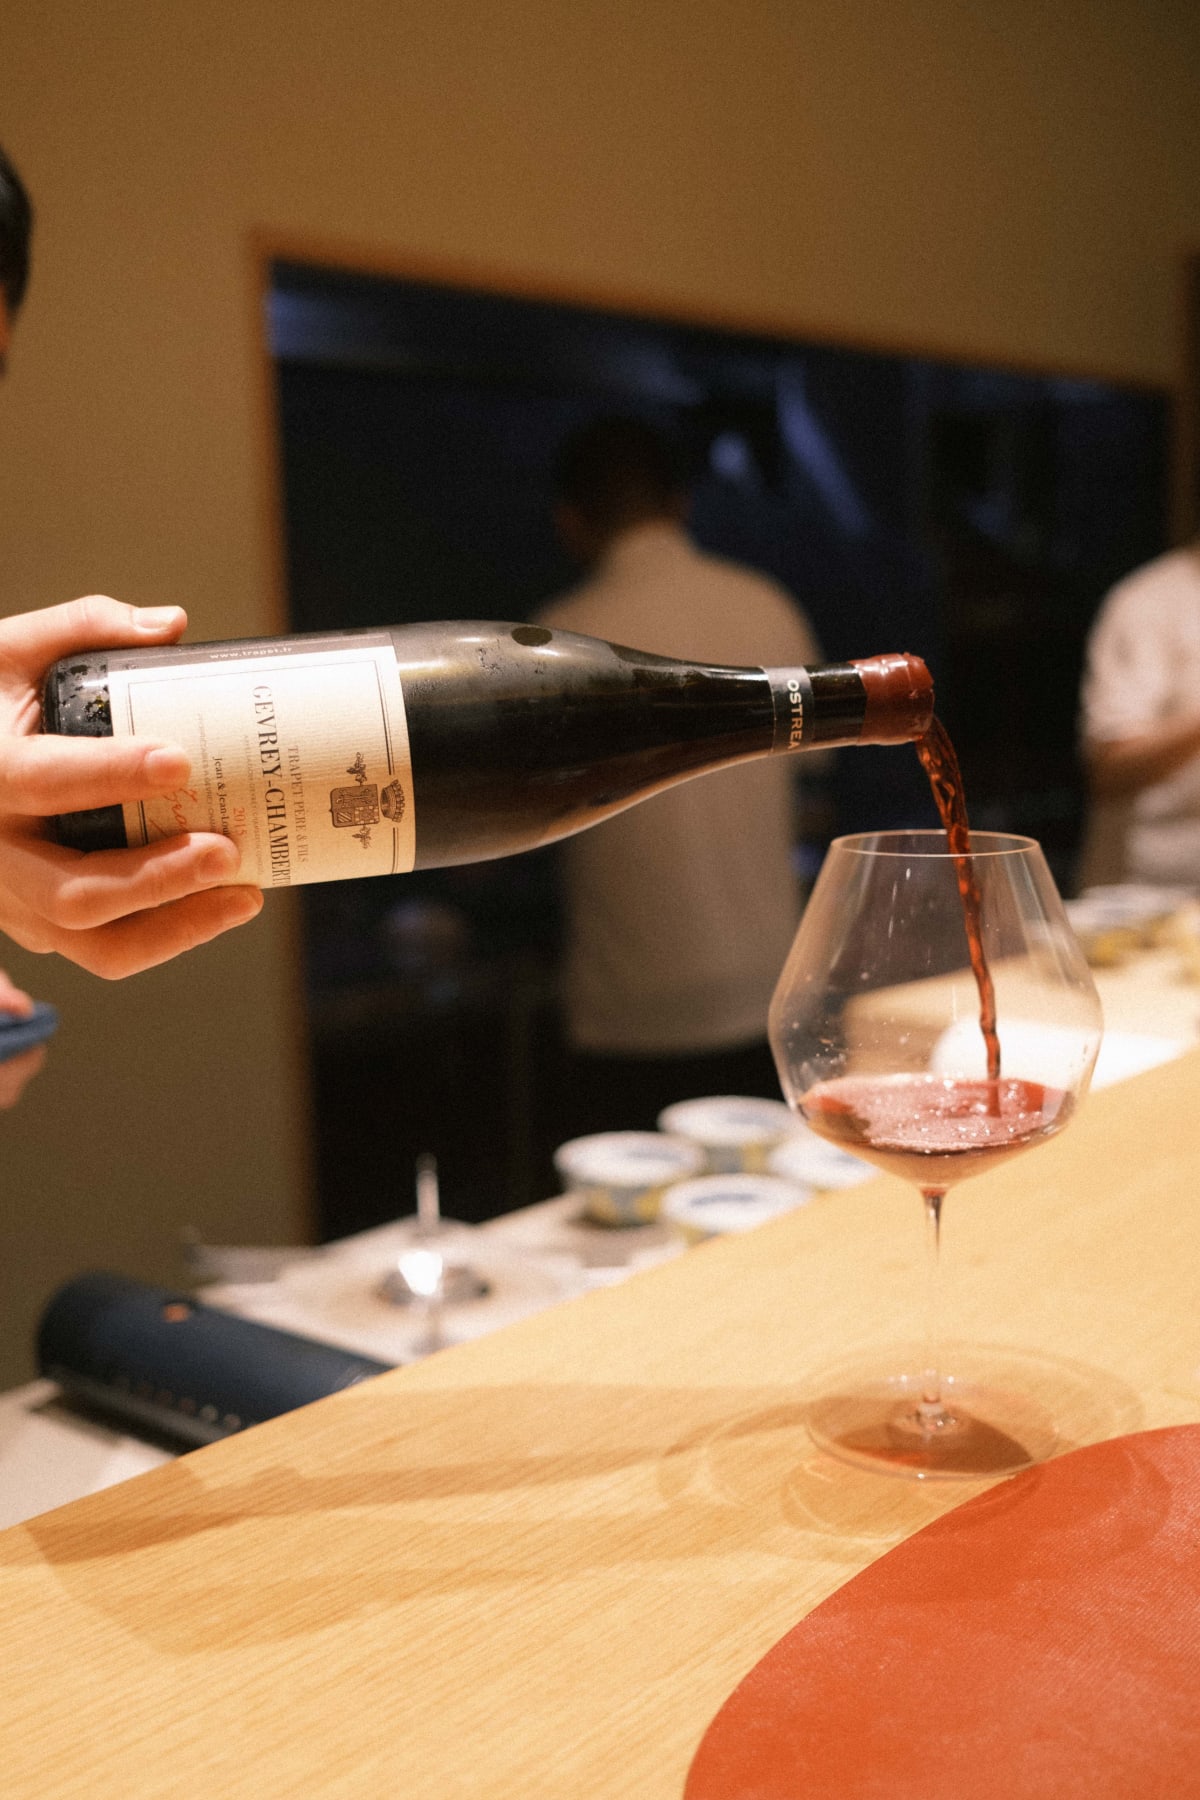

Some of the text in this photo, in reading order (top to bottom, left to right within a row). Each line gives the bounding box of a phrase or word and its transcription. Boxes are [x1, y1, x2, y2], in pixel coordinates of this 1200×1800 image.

[209, 647, 292, 659] www.trapet.fr
[787, 679, 804, 750] OSTREA
[252, 685, 292, 887] GEVREY-CHAMBERTI
[287, 745, 305, 798] TRAPET
[212, 756, 231, 837] Jean & Jean-Loui
[233, 807, 247, 836] 2015
[296, 834, 307, 842] &
[297, 844, 310, 863] FILS
